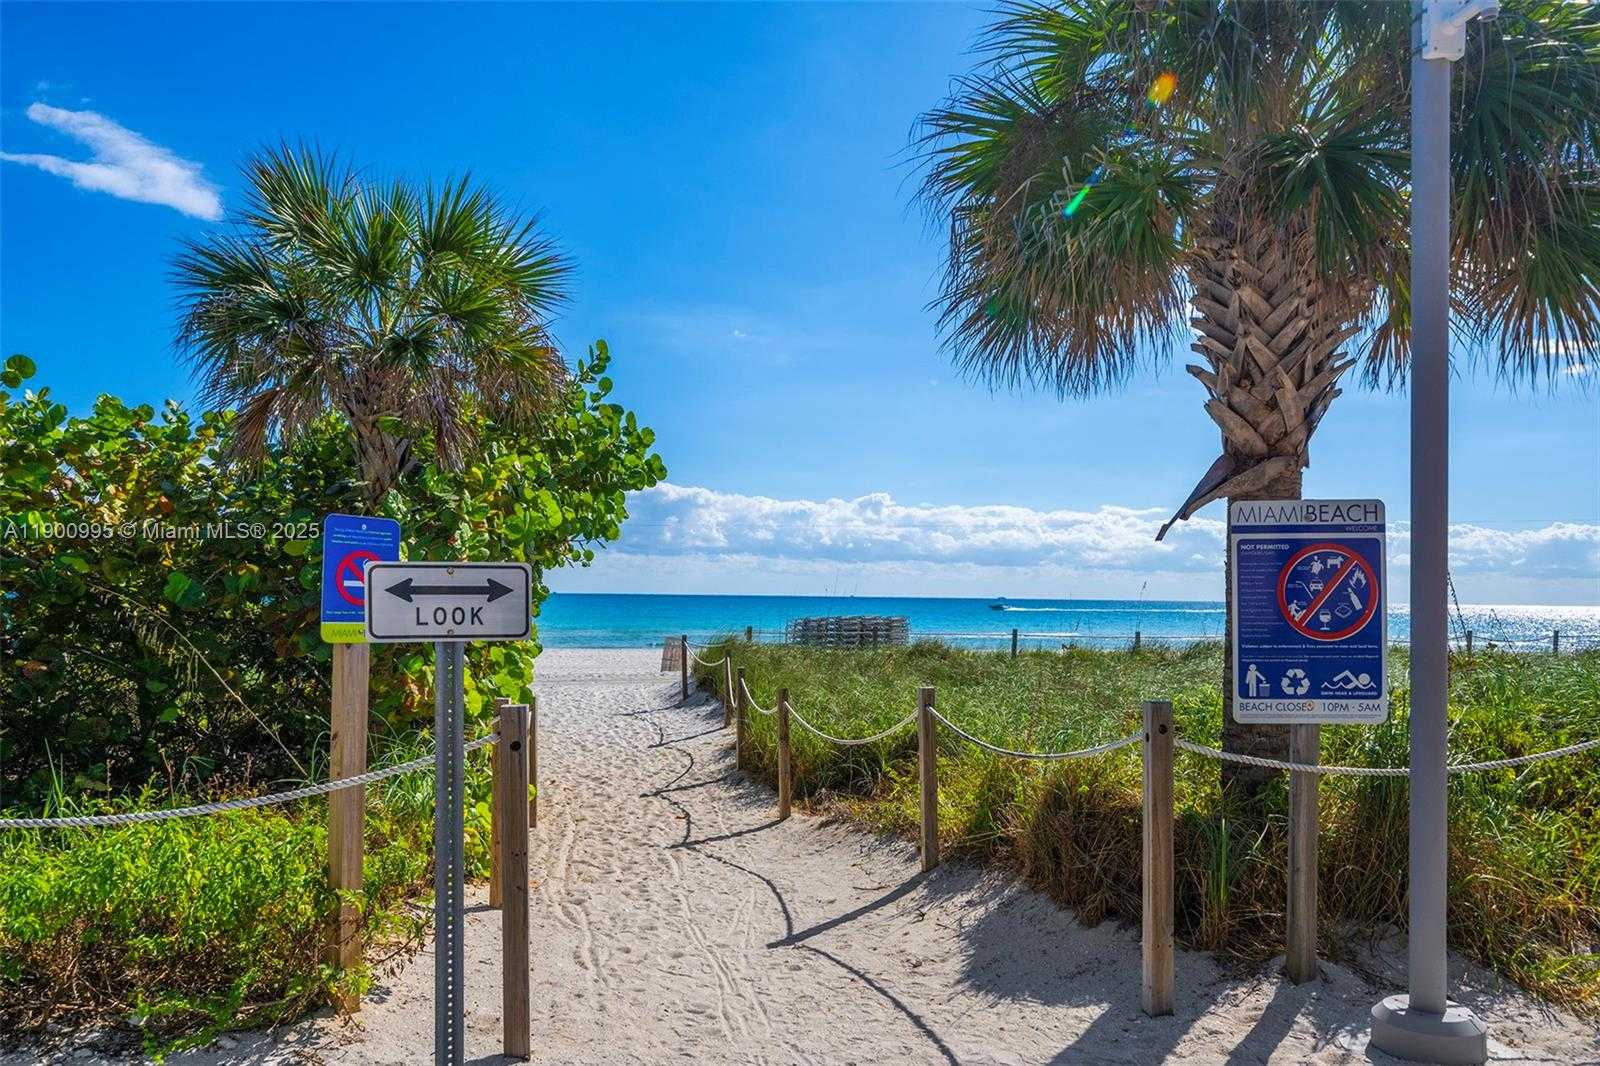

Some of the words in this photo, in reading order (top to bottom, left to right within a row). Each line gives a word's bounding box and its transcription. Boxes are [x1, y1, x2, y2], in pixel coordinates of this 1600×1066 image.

[416, 606, 484, 625] LOOK
[1240, 702, 1273, 712] BEACH
[1322, 702, 1350, 712] 10PM
[1358, 702, 1382, 712] 5AM
